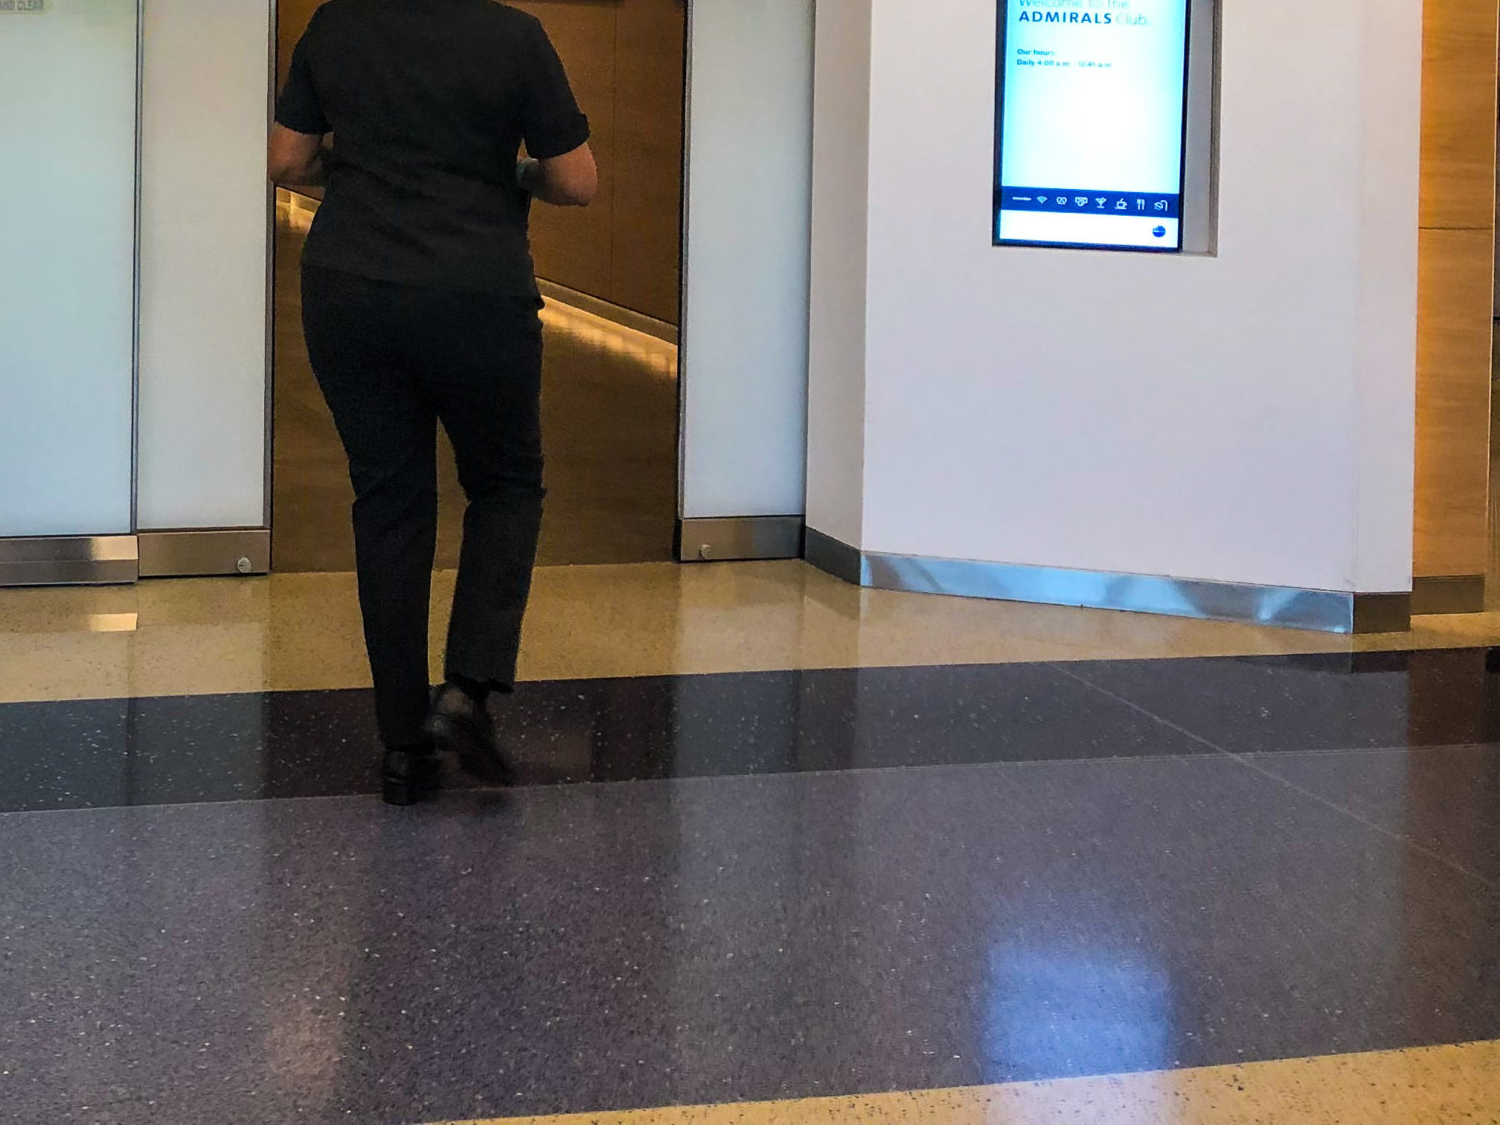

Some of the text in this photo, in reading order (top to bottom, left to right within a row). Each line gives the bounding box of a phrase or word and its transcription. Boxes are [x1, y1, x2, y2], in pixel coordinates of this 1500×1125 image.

[17, 0, 45, 11] CLEAR
[1018, 10, 1112, 24] ADMIRALS
[1016, 48, 1031, 56] Our
[1016, 59, 1035, 67] Daily
